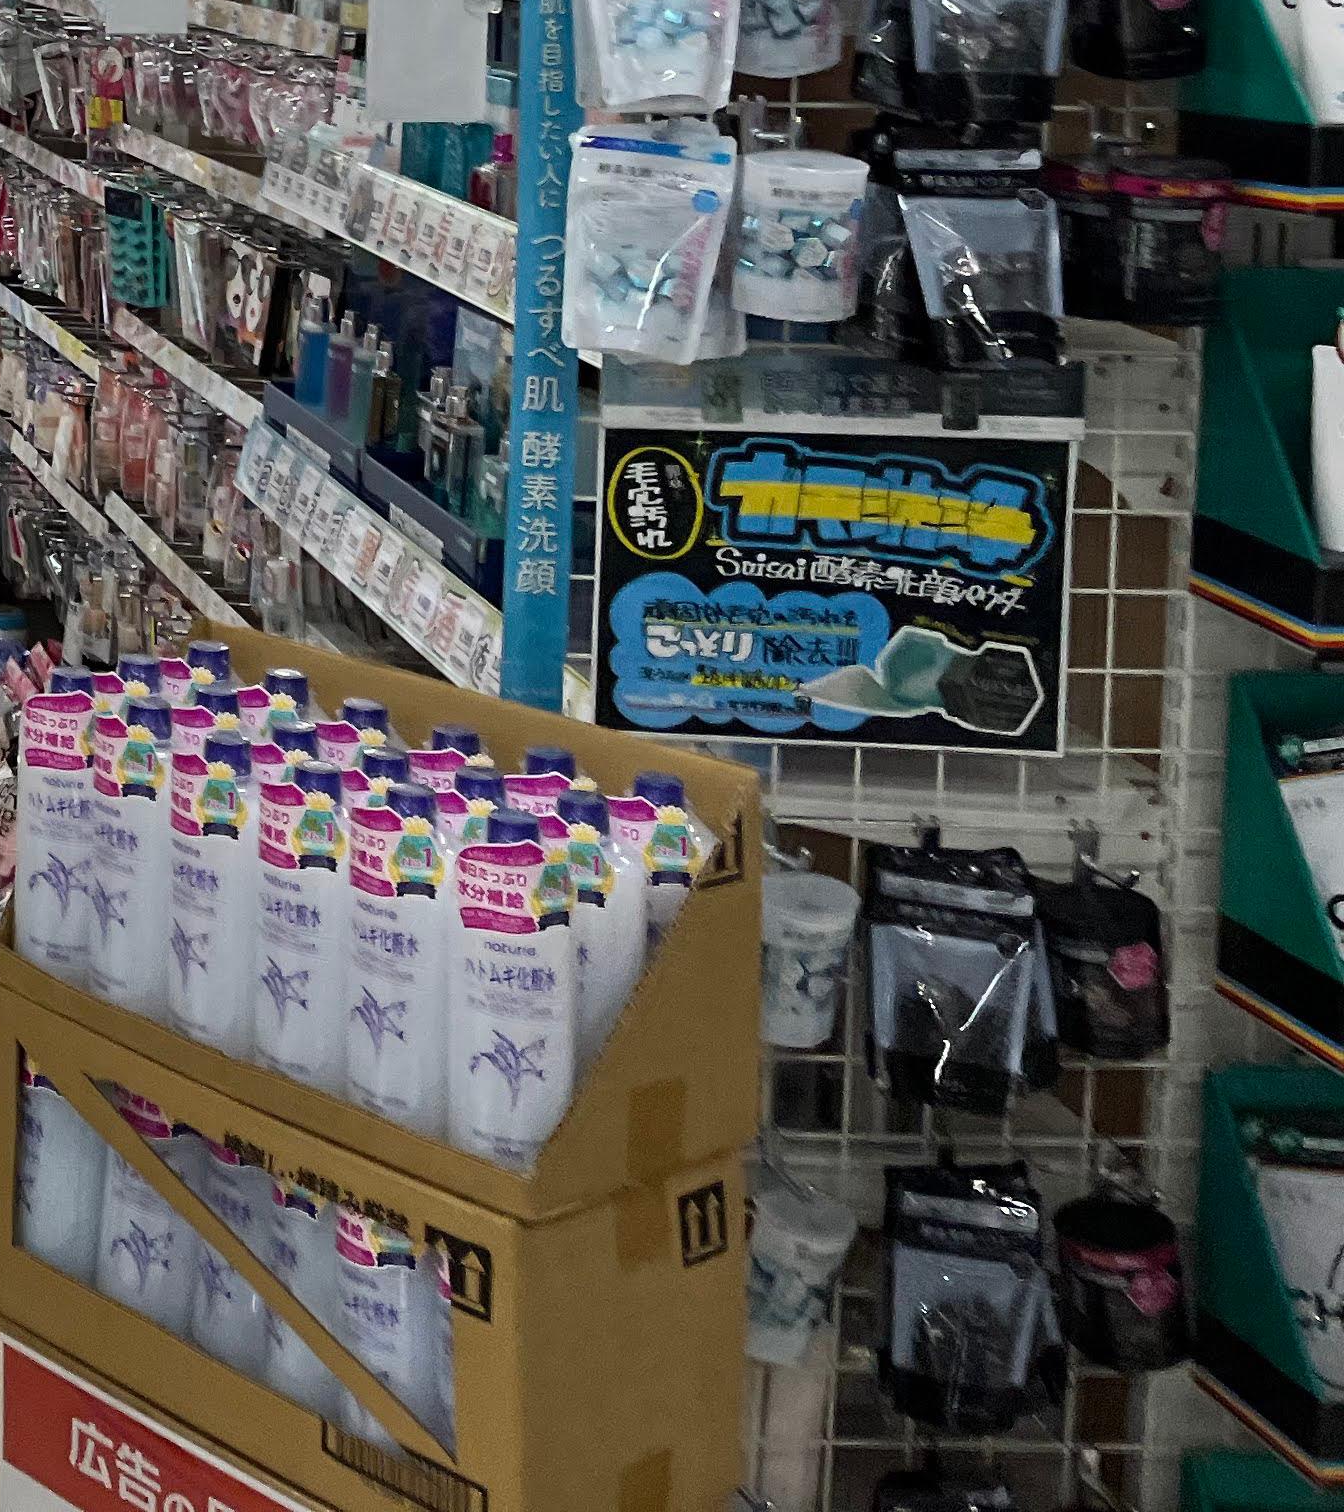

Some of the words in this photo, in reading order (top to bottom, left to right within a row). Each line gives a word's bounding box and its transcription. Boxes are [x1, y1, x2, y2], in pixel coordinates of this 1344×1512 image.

[514, 431, 563, 596] 酵素洗顔
[623, 462, 673, 549] 毛穴汚れ
[456, 878, 525, 910] 水分補給
